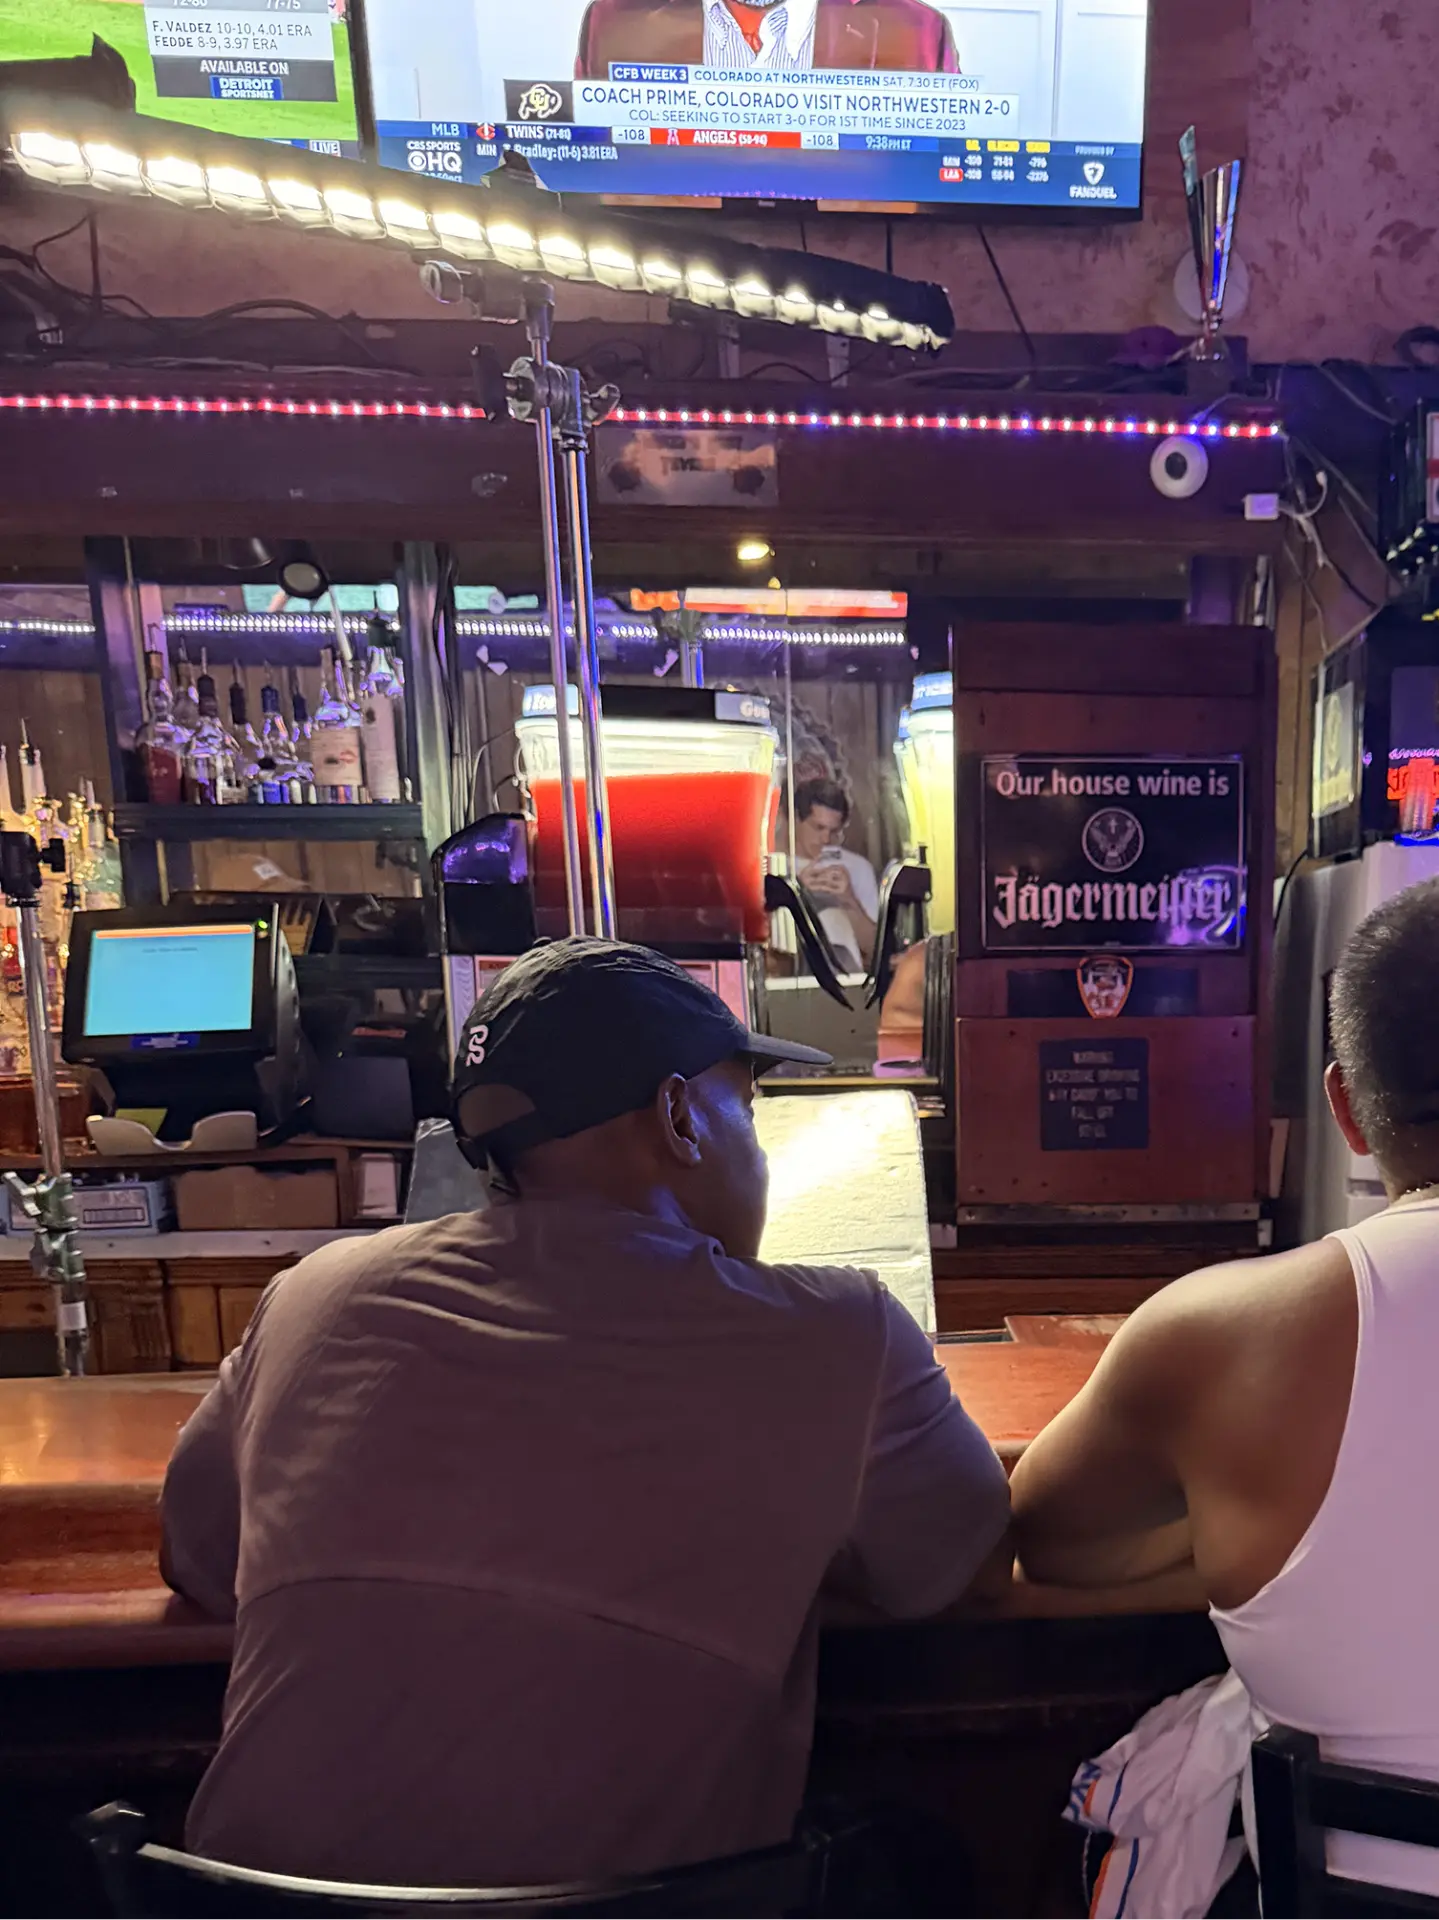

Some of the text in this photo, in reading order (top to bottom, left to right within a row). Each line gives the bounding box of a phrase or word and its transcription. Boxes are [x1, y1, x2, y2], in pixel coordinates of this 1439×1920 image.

[152, 20, 312, 37] F. VALDEZ 10-10, 4.01 ERA
[154, 35, 278, 50] FEDDE 8-9, 3.97 ERA
[200, 59, 289, 75] AVAILABLE ON
[219, 77, 274, 91] DETROIT
[613, 68, 639, 80] CFB
[640, 69, 678, 81] WEEK
[679, 70, 687, 81] 3
[694, 70, 762, 82] COLORADO
[765, 73, 780, 83] AT
[782, 73, 880, 86] NORTHWESTERN
[932, 79, 946, 89] ET
[949, 79, 980, 91] (FOX)
[220, 90, 275, 99] SPORTSNET
[582, 86, 1011, 115] COACH PRIME, COLORADO VISIT NORTHWESTERN 2-0
[628, 109, 966, 131] COL: SEEKING TO START 3-0 FOR 1ST TIME SINCE 2023
[431, 123, 460, 136] MLB
[505, 125, 544, 139] TWINS
[617, 130, 645, 141] -108
[693, 130, 737, 145] ANGELS
[806, 135, 833, 147] -108
[407, 140, 461, 151] CBS SPORTS
[476, 144, 498, 157] MIN
[901, 139, 912, 151] ET
[600, 147, 619, 160] ERA
[426, 151, 463, 173] HQ
[995, 768, 1230, 797] Our house wine is
[992, 868, 1233, 930] Jägermeister
